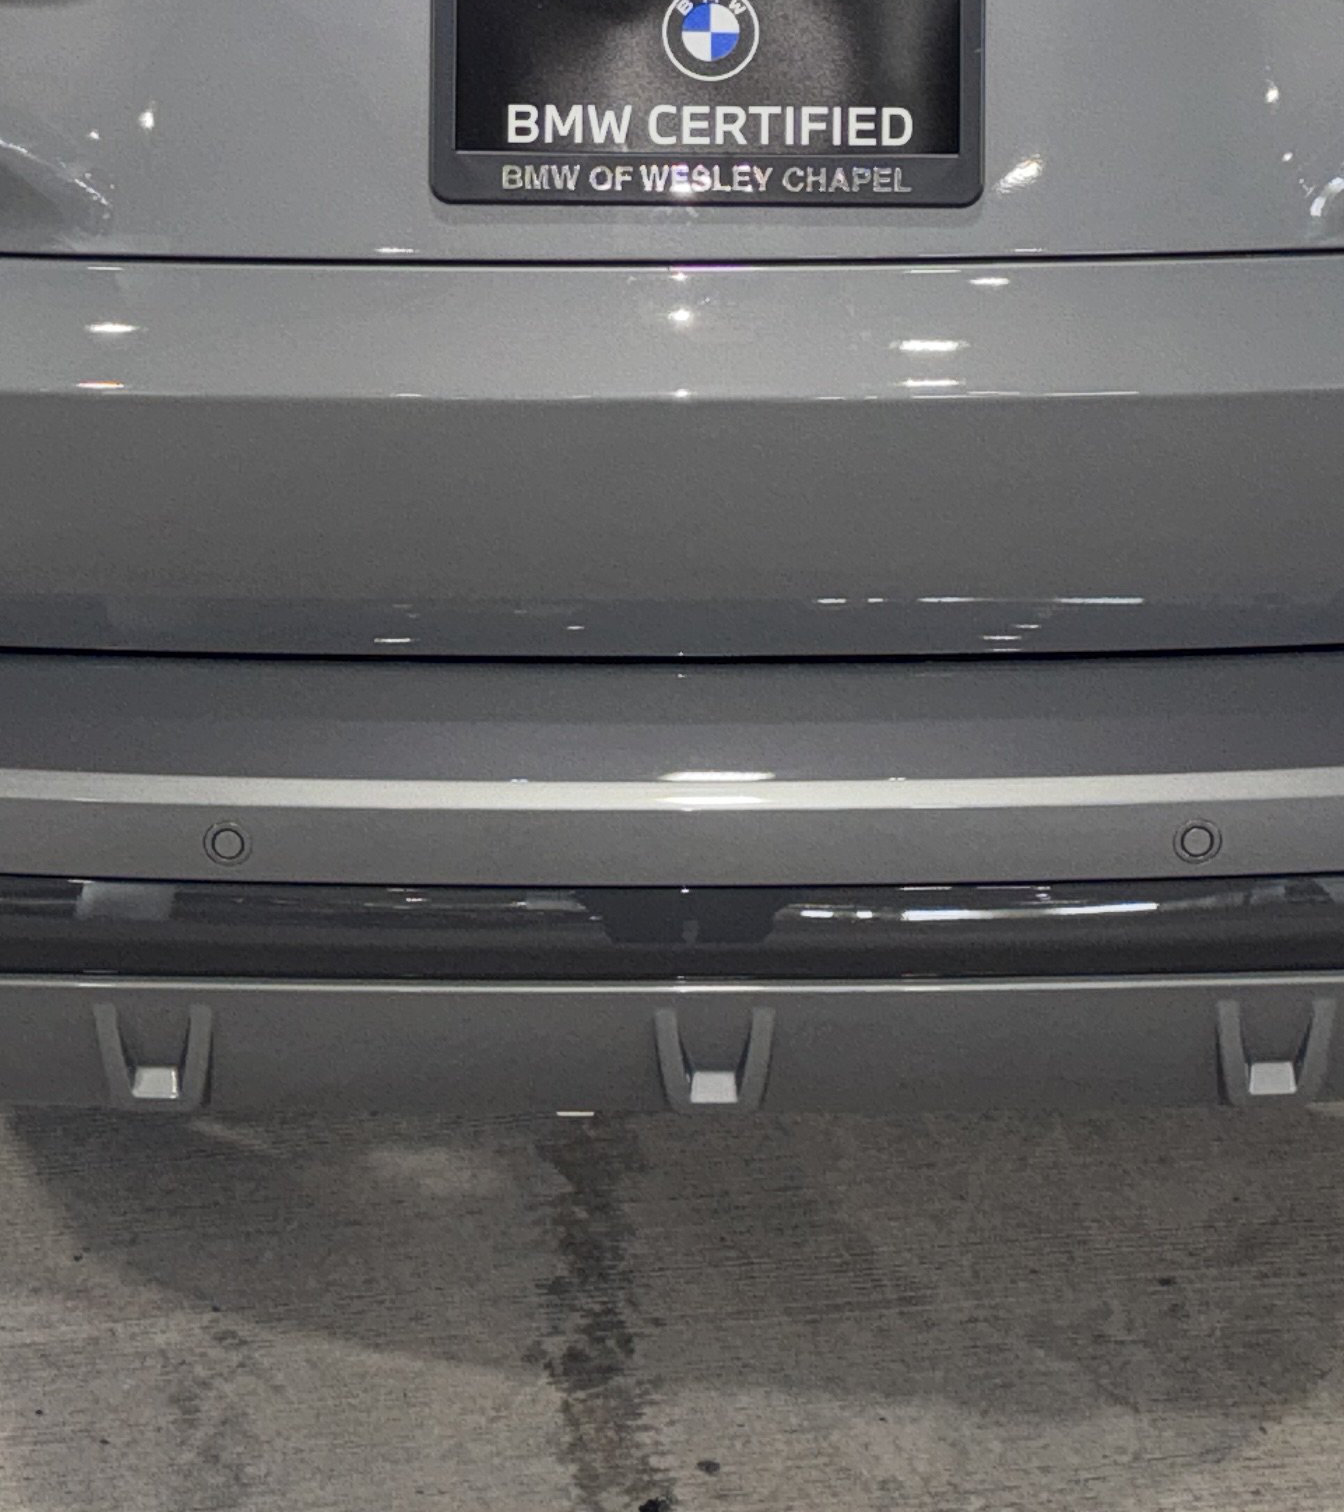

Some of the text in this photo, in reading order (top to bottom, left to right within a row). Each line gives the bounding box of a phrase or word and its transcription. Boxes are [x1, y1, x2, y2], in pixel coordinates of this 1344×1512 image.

[507, 104, 913, 147] BMW CERTIFIED
[502, 163, 912, 193] BMW OF WESLEY CHAPEL
